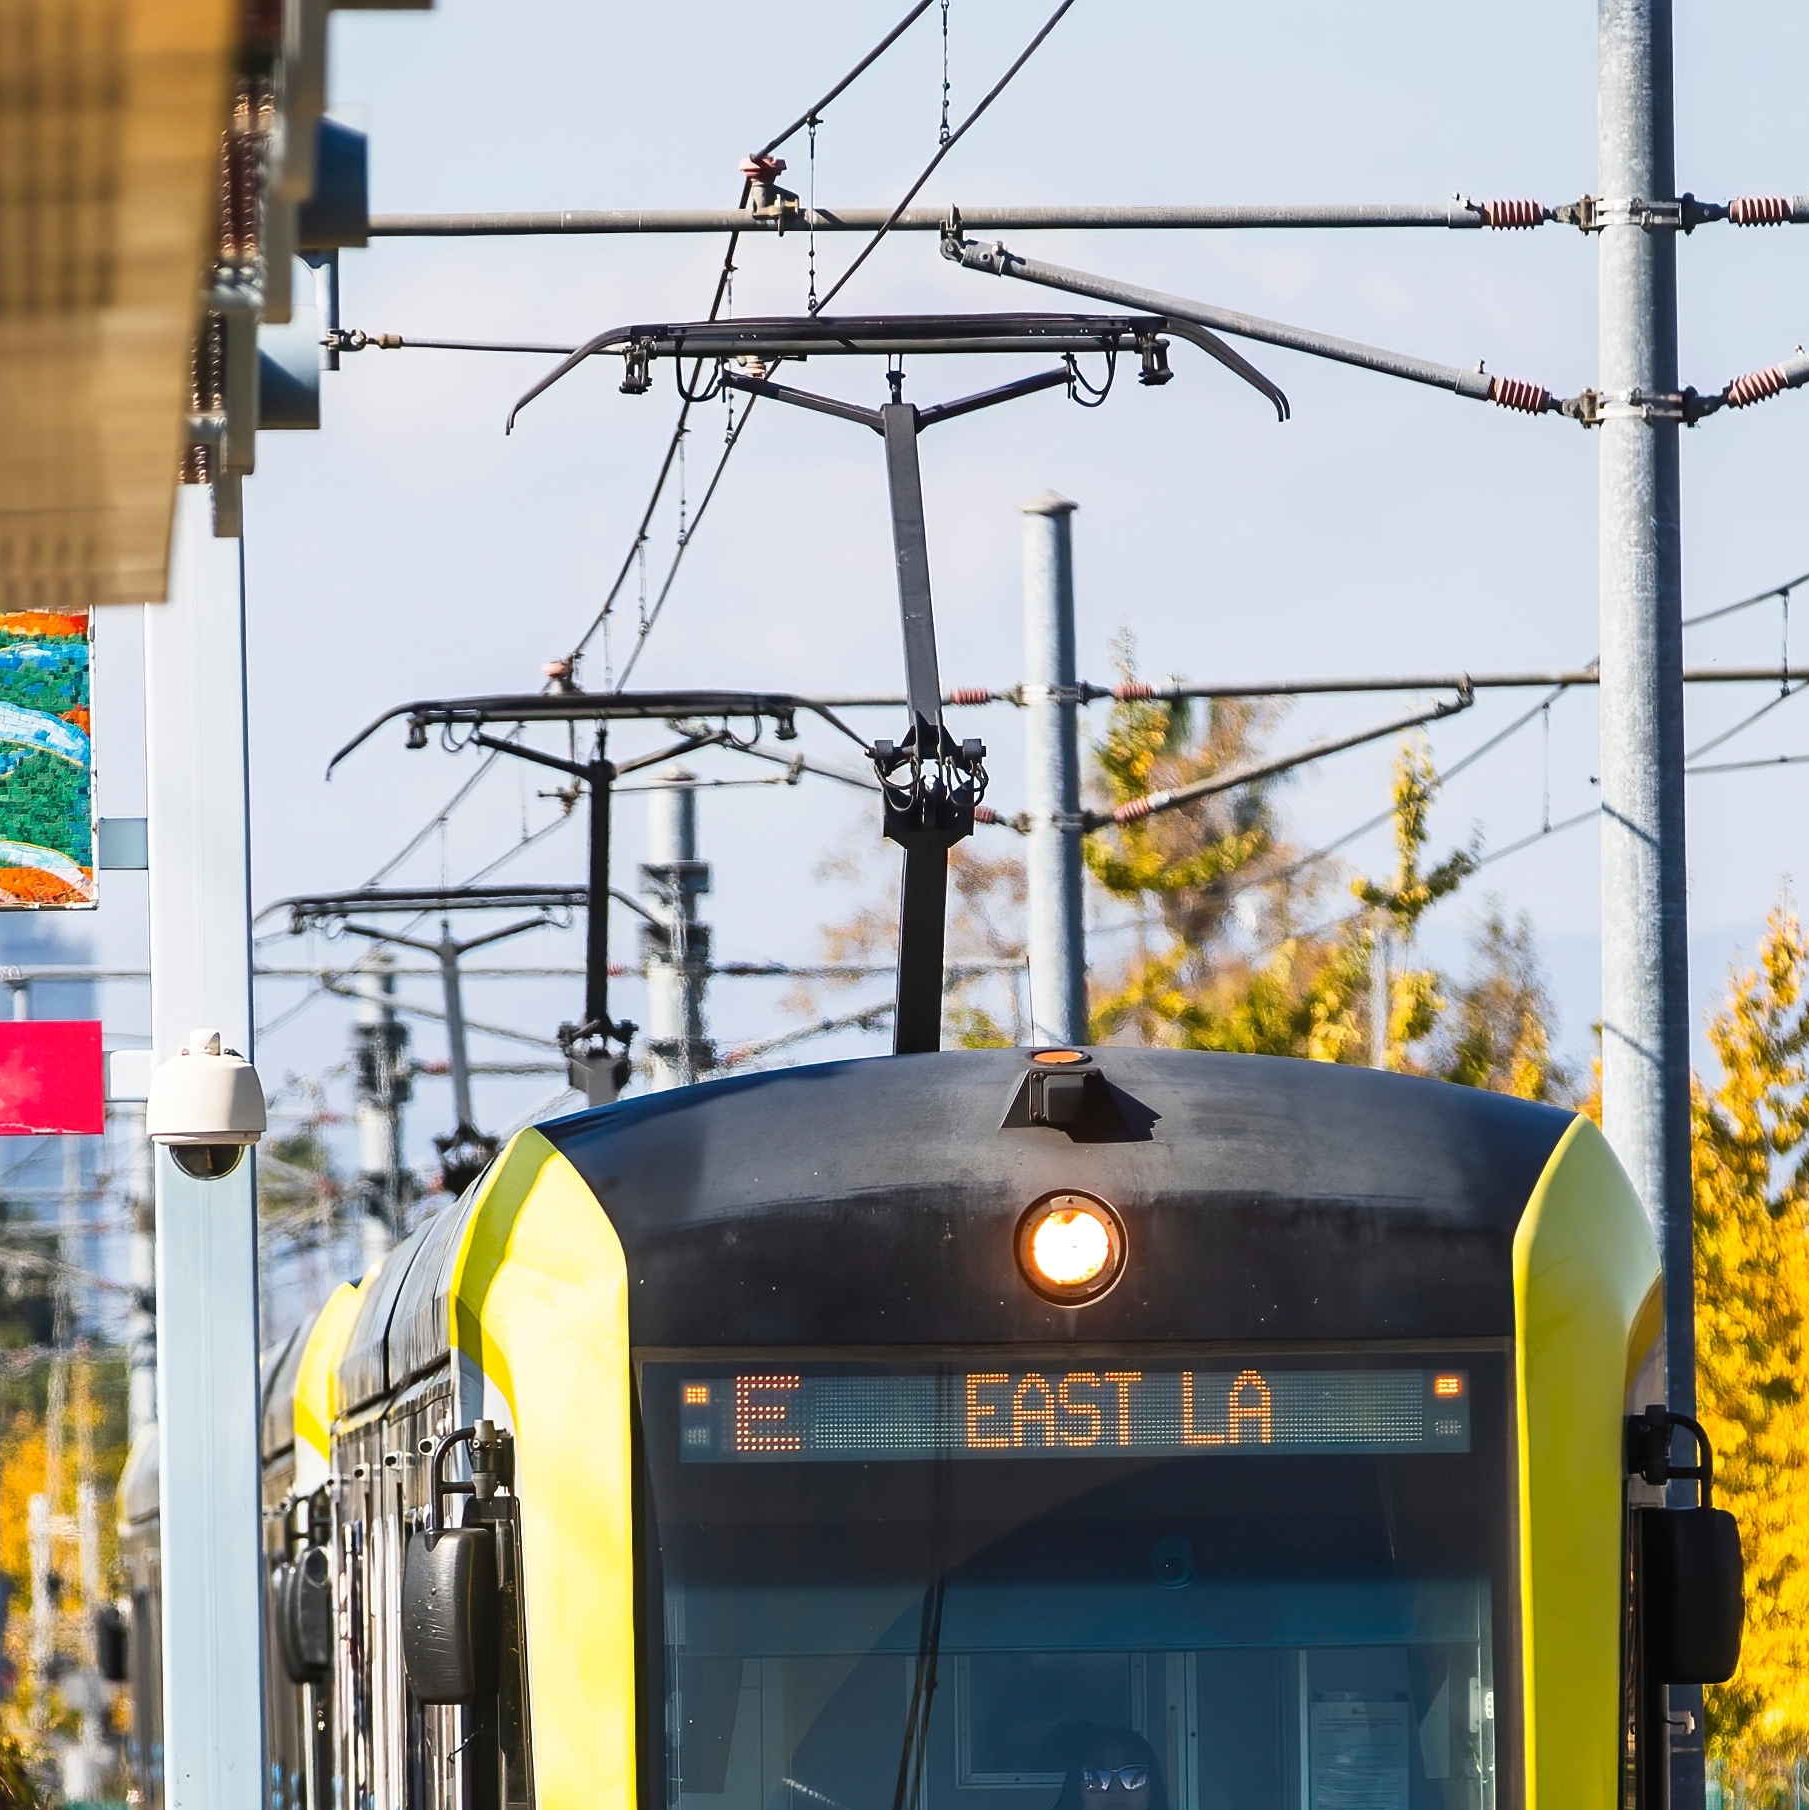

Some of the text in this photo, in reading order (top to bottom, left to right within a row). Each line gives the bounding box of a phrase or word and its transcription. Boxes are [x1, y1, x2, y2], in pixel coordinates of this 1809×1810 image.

[735, 1369, 1273, 1452] E EAST LA
